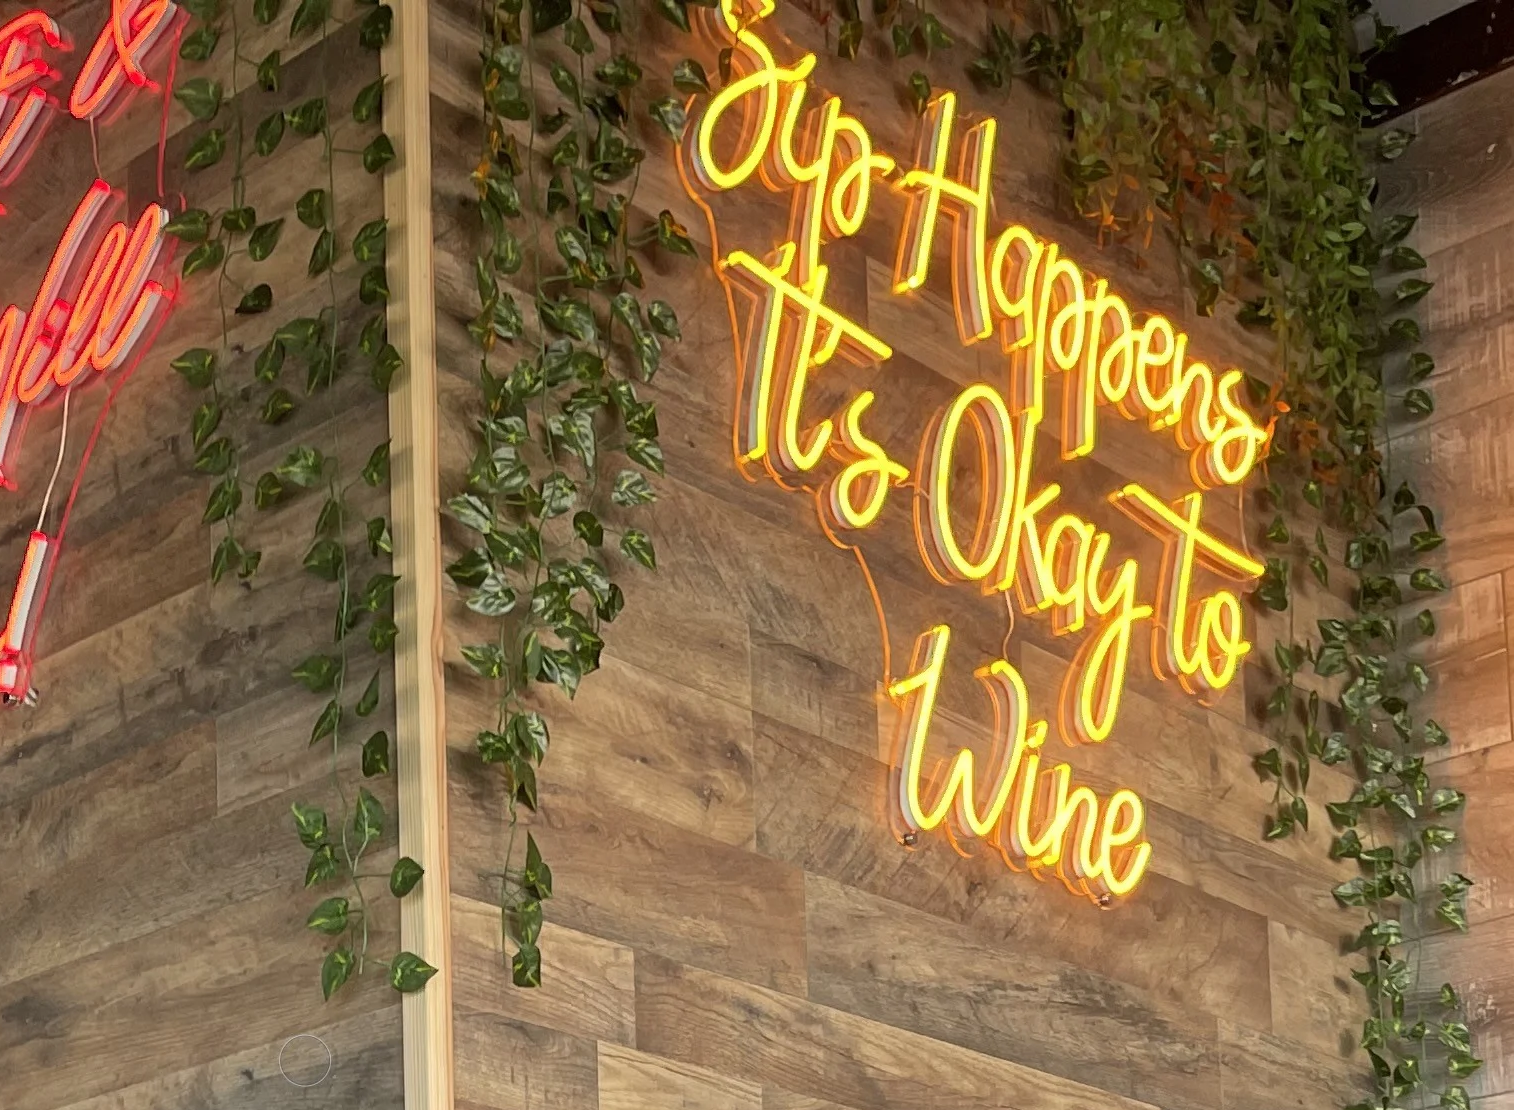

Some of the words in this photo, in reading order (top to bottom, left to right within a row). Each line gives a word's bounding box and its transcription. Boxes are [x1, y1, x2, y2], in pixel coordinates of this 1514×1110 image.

[68, 0, 178, 120] &
[895, 90, 1266, 485] Happens
[933, 383, 1153, 742] Okay
[891, 624, 1151, 895] Wine
